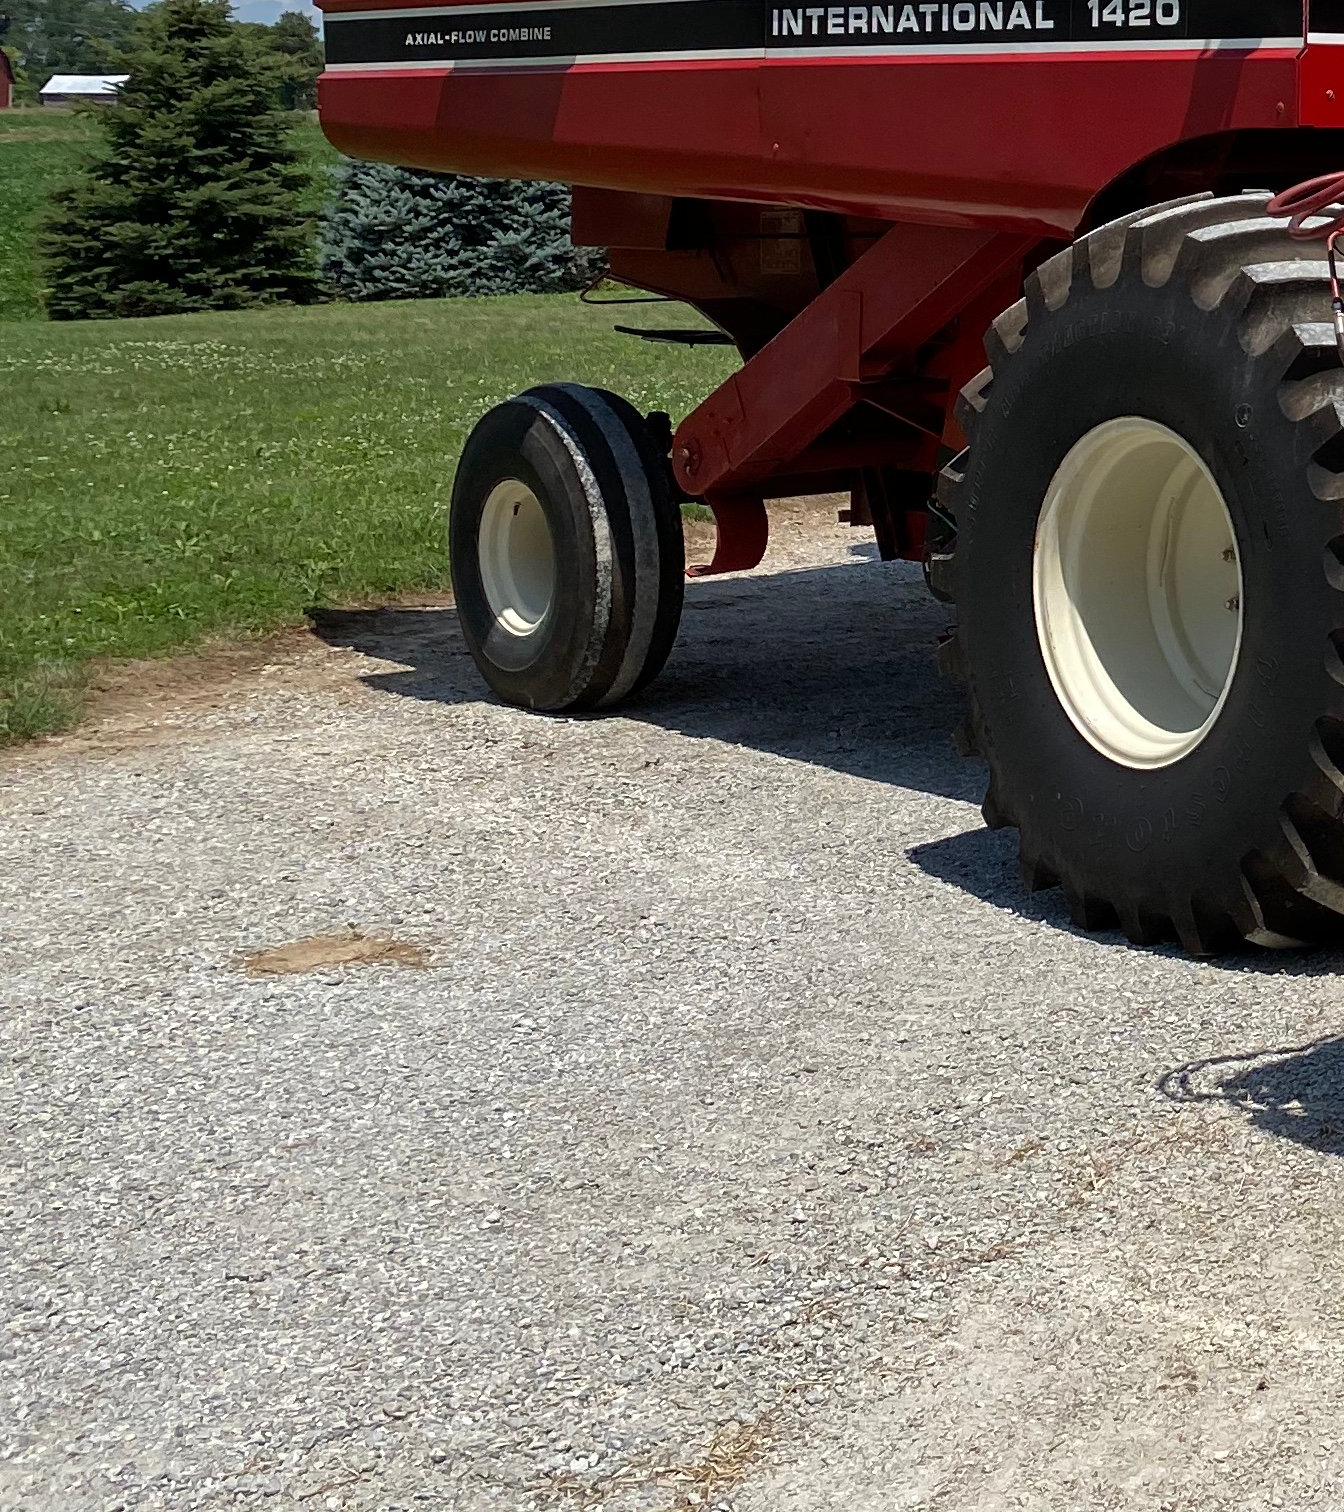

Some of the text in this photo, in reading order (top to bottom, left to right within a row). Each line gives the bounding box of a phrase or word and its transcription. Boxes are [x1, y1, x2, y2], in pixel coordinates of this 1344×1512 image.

[772, 0, 1054, 36] INTERNATIONAL
[405, 26, 551, 46] AXIAL-FLOW COMBINE
